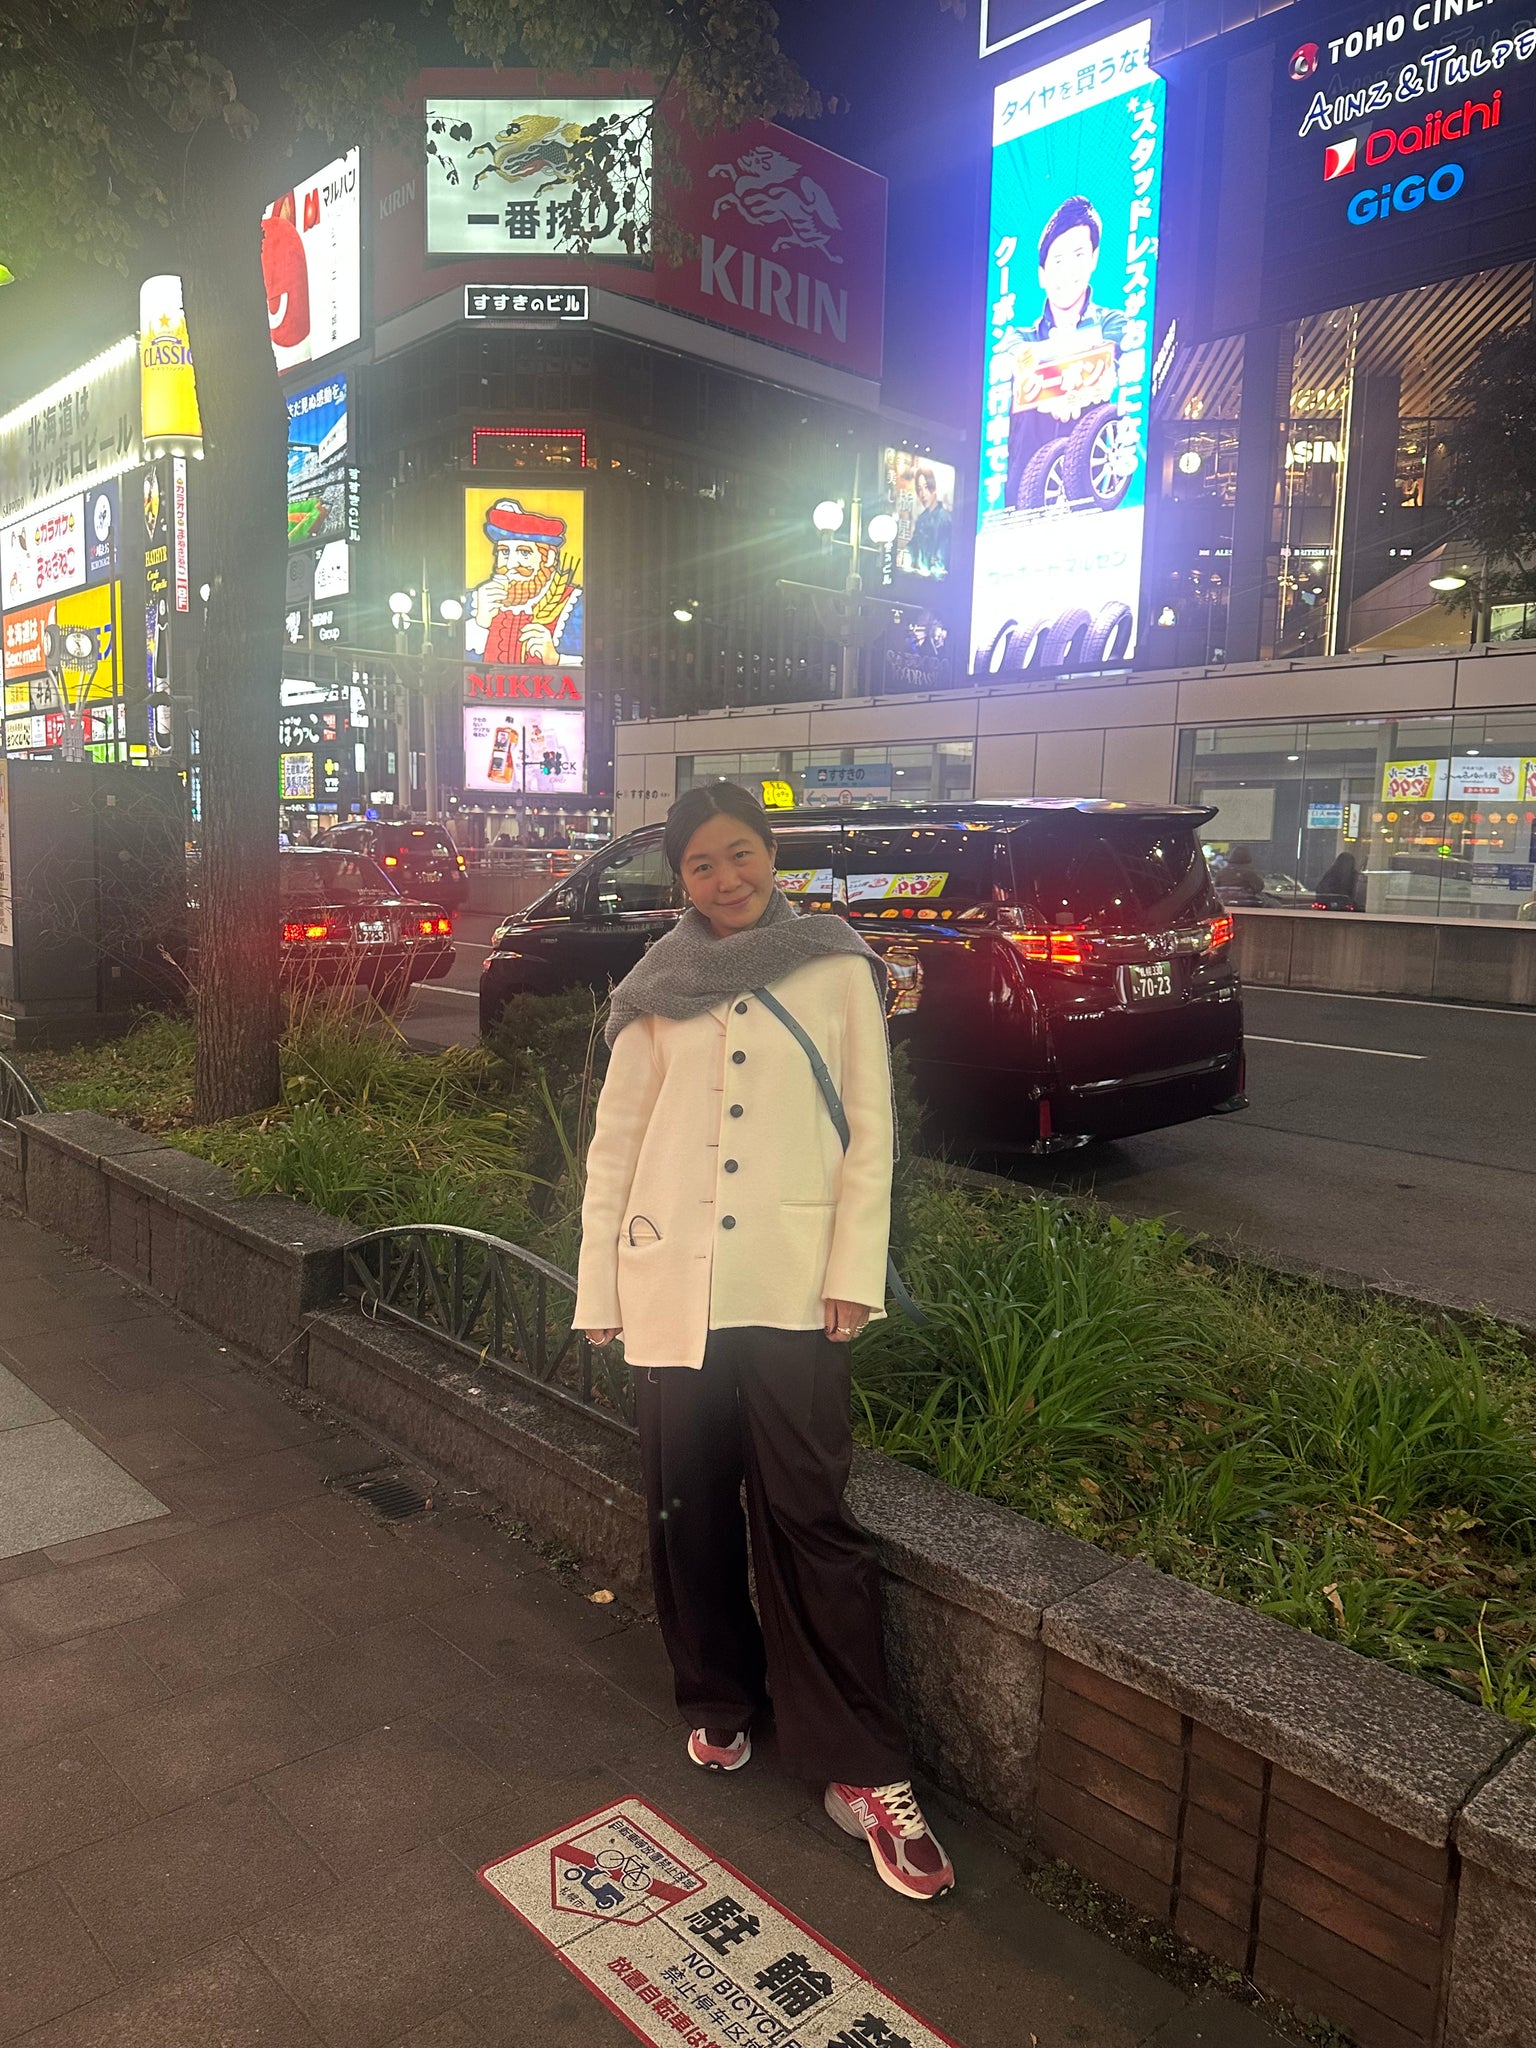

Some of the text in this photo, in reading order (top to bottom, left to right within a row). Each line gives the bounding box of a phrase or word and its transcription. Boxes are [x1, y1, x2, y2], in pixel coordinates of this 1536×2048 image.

[1328, 0, 1494, 64] TOHO CINE
[1365, 90, 1503, 166] Daiichi
[323, 168, 356, 207] マルハン
[379, 180, 416, 220] KIRIN
[1347, 163, 1465, 226] GiGO
[472, 294, 581, 314] すすきのビル
[701, 235, 848, 344] KIRIN
[1113, 105, 1158, 478] スタッドレスがおになる
[984, 236, 1018, 506] クーポン行中です
[28, 386, 89, 456] 北海道は
[29, 413, 132, 500] サッポロビール
[40, 514, 69, 543] カラオケ
[36, 547, 75, 589] まねきねこ
[467, 674, 582, 699] NIKKA
[630, 789, 659, 800] すすきの
[828, 768, 865, 781] すすきの
[1139, 975, 1172, 998] 70-23
[682, 1952, 715, 1979] NO
